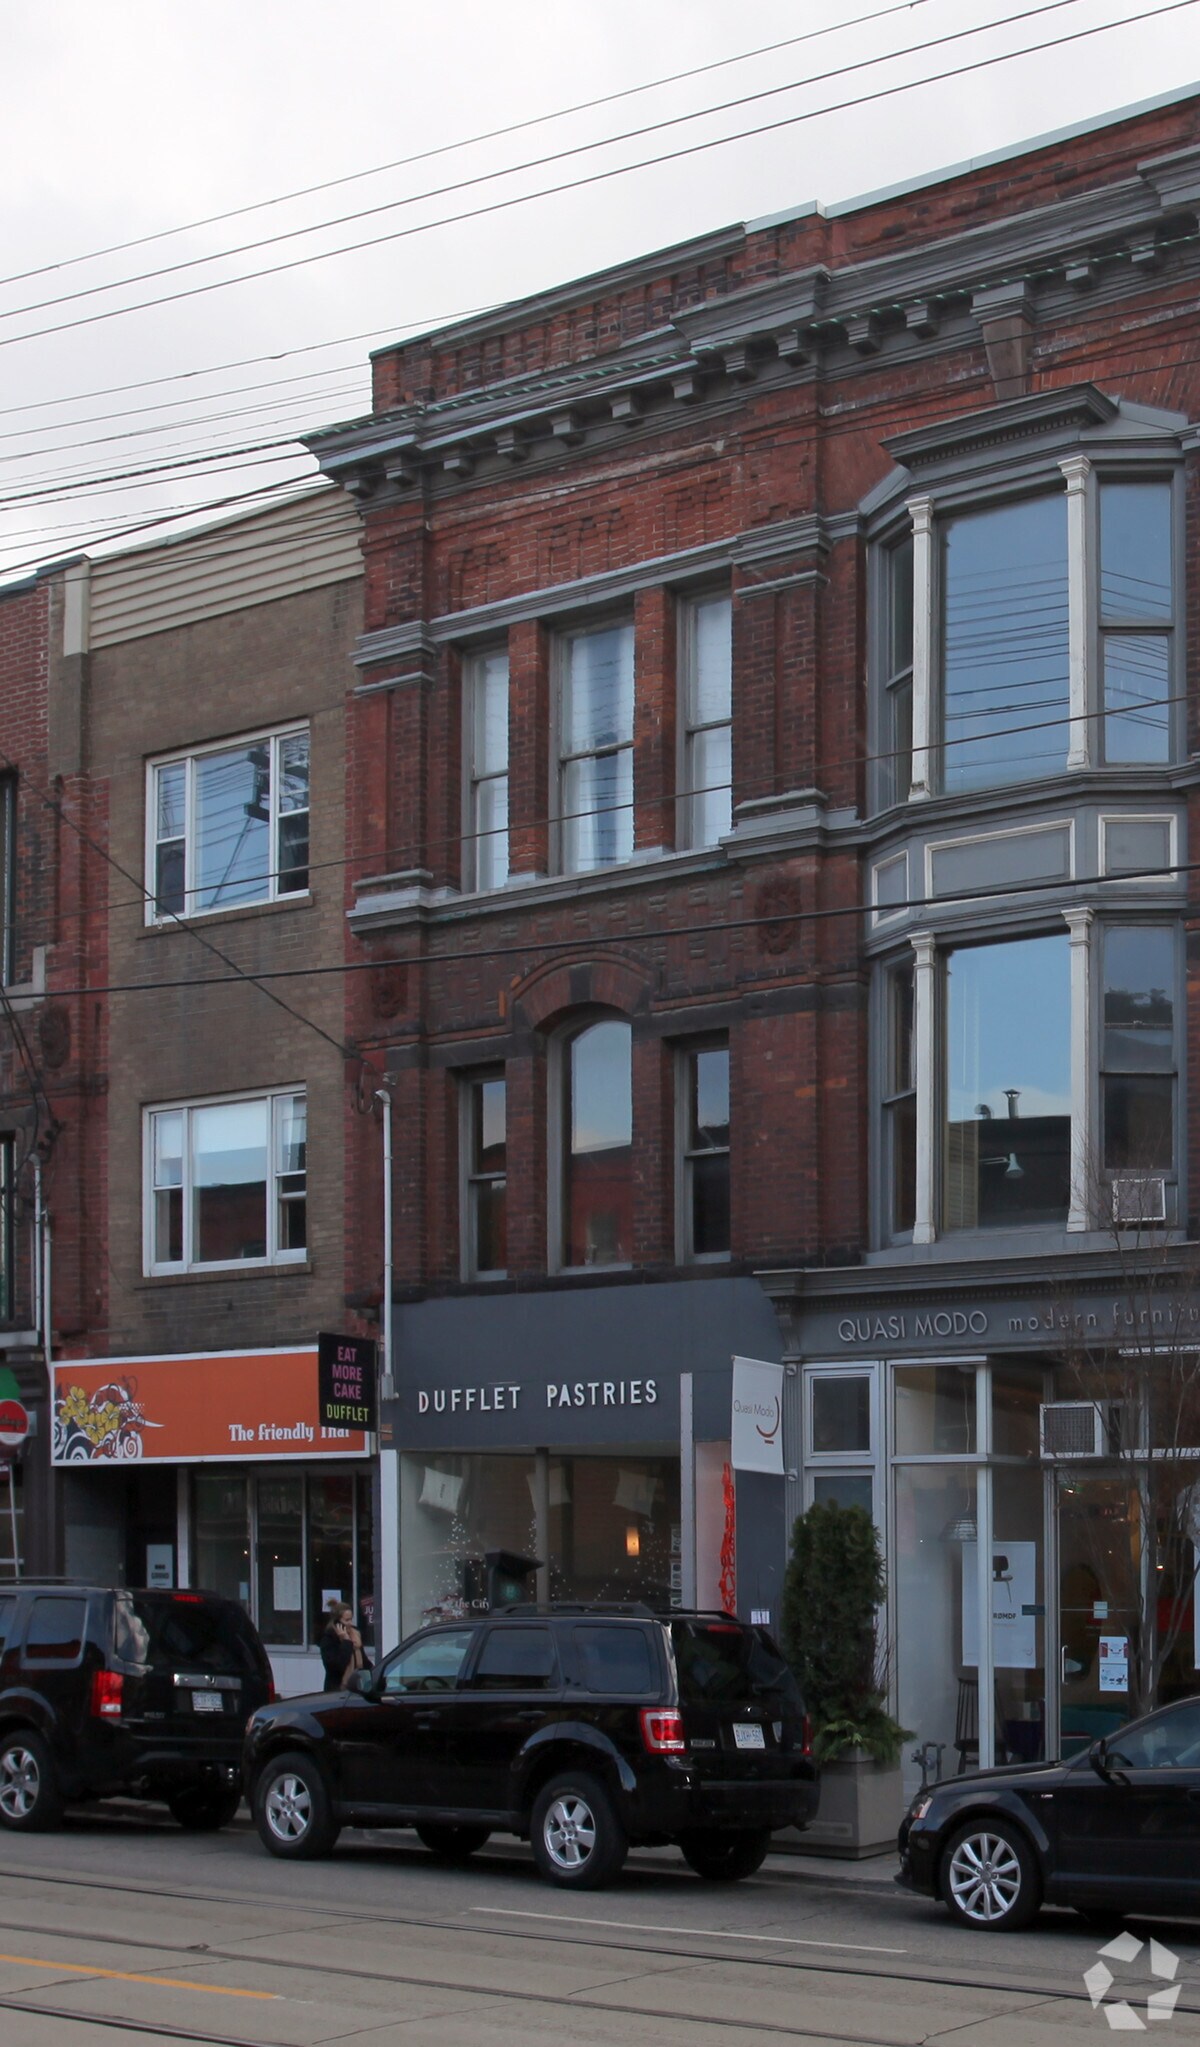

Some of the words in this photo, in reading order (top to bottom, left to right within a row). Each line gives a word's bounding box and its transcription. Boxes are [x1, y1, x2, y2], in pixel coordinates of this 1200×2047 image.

[837, 1315, 906, 1343] QUASI
[915, 1310, 988, 1337] MODO
[1008, 1307, 1097, 1333] modern
[337, 1346, 357, 1362] EAT
[332, 1364, 363, 1382] MORE
[333, 1382, 362, 1400] CAKE
[418, 1386, 521, 1414] DUFFLET
[546, 1379, 658, 1408] PASTRIES
[326, 1403, 369, 1423] DUFFLET
[733, 1399, 753, 1416] Quasi
[754, 1403, 775, 1418] Modo
[228, 1424, 254, 1442] The
[257, 1422, 314, 1443] friendly
